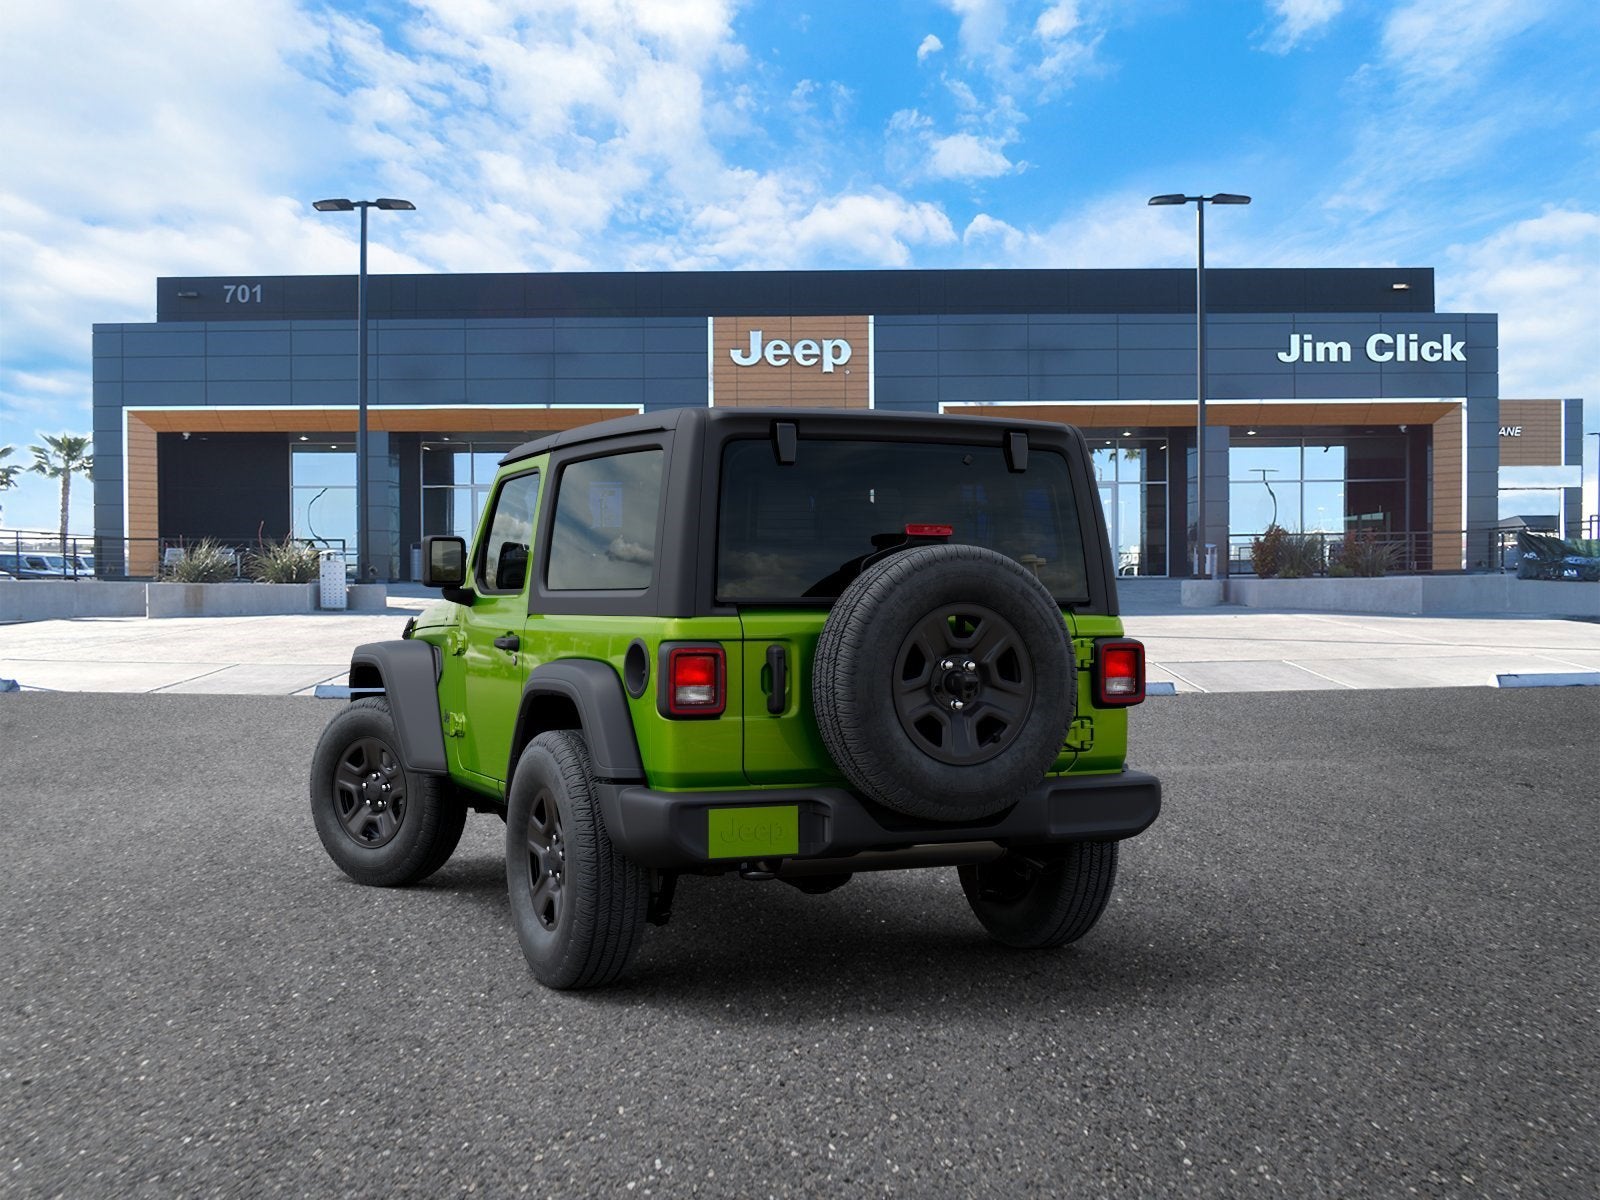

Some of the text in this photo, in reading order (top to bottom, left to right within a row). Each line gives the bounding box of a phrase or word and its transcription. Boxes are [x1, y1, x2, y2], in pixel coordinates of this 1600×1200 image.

[223, 284, 262, 303] 701
[729, 330, 852, 373] Jeep
[1277, 333, 1467, 363] Jim Click
[720, 815, 785, 848] Jeep
